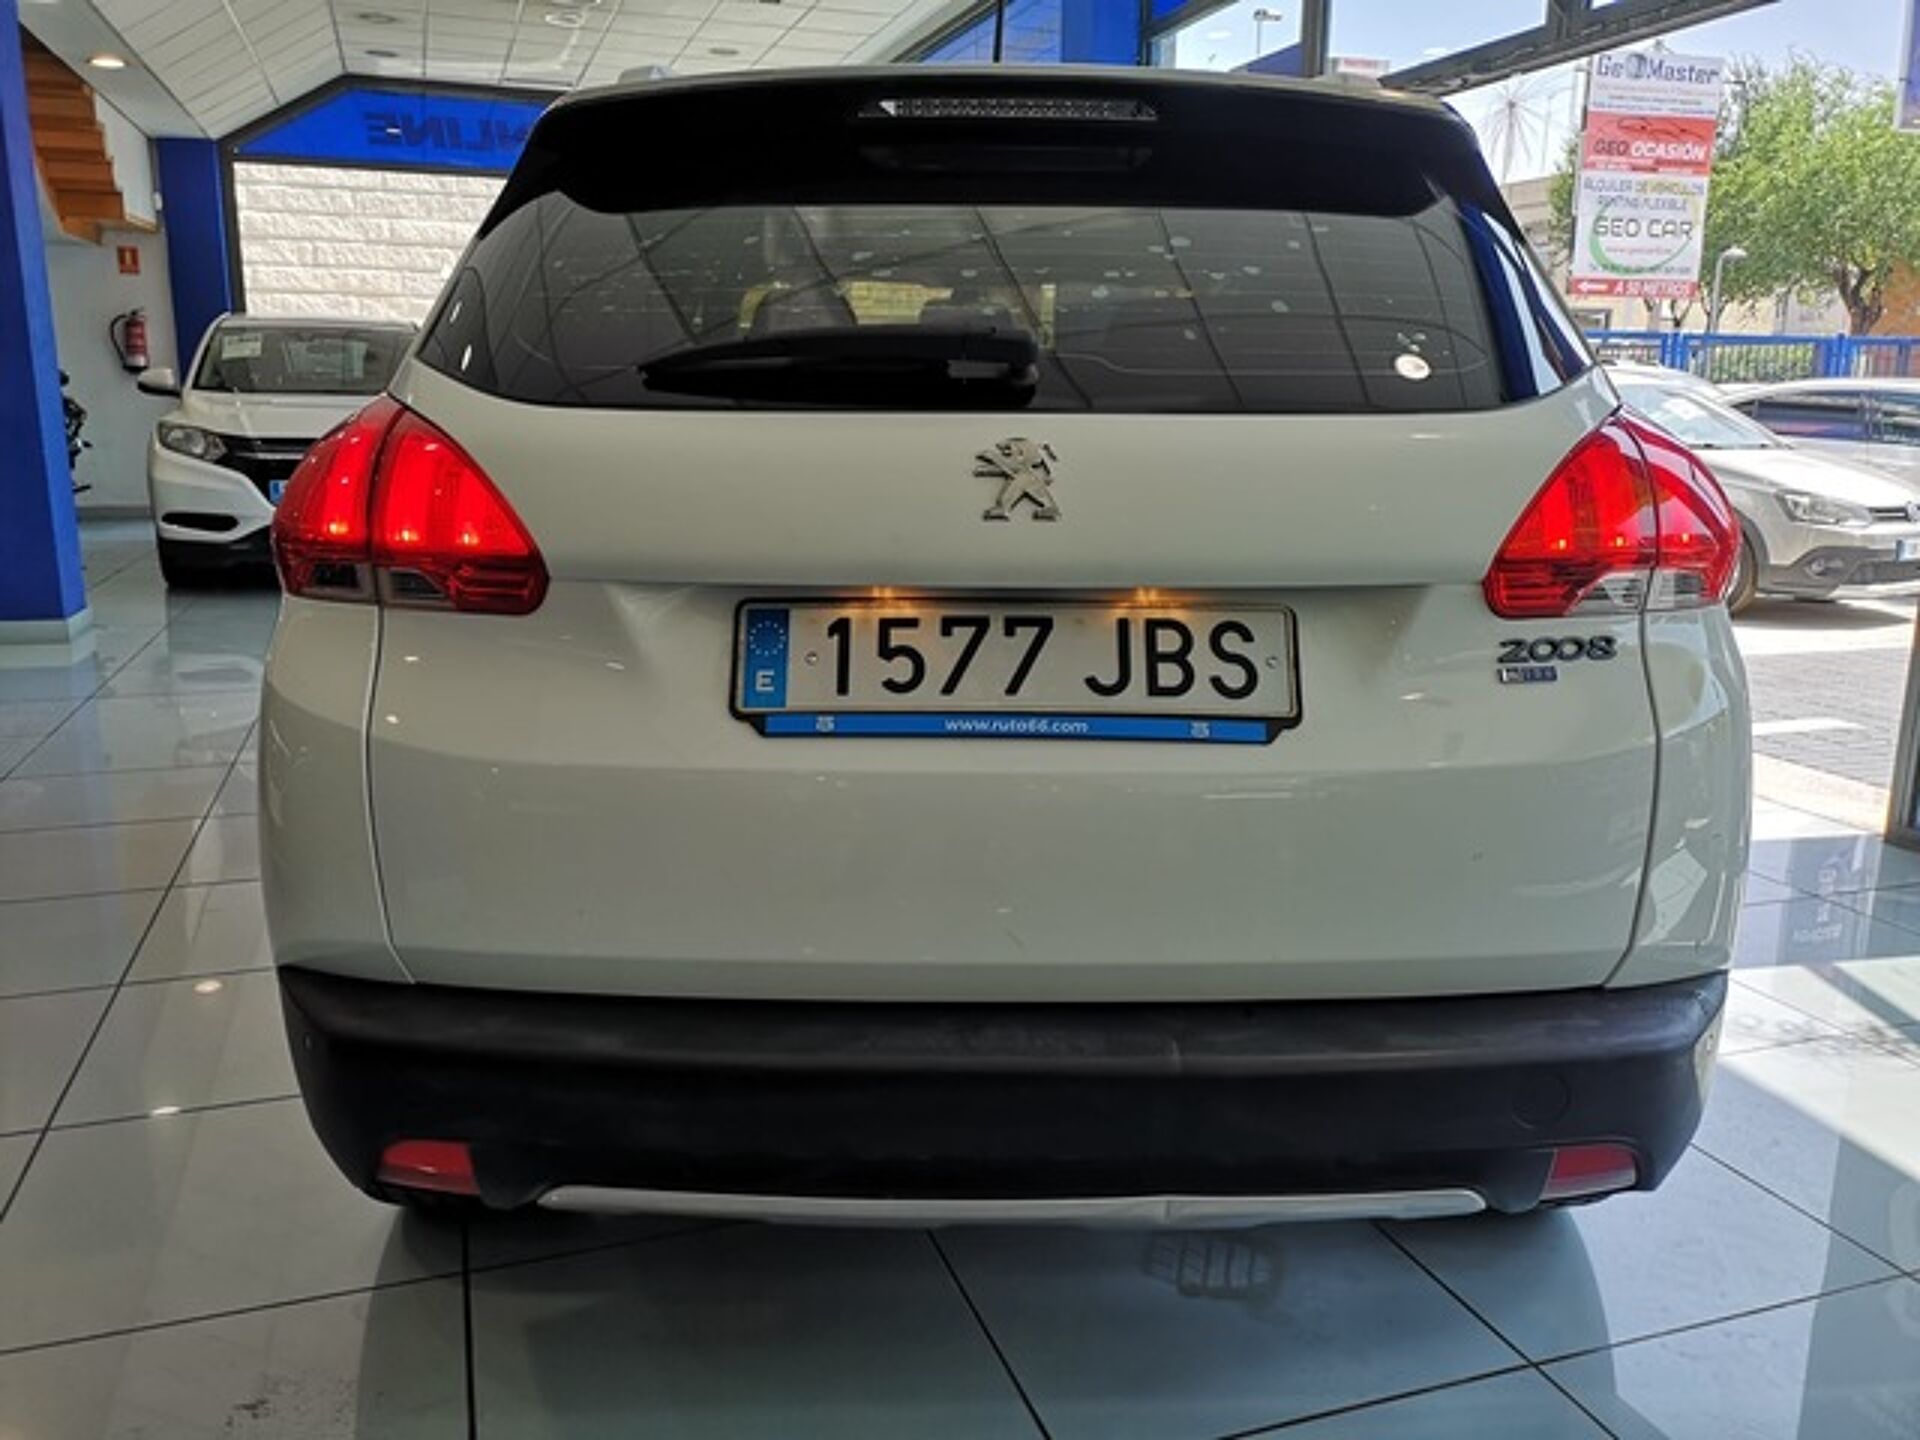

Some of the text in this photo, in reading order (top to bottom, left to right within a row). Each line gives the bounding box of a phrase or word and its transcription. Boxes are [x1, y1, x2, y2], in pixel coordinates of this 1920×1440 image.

[1593, 139, 1706, 160] GEO OCASIÓN
[1593, 217, 1693, 240] GEO CAR
[1614, 281, 1624, 294] A
[827, 616, 1258, 700] 1577 JBS
[1497, 635, 1617, 663] 2008
[756, 670, 775, 692] E
